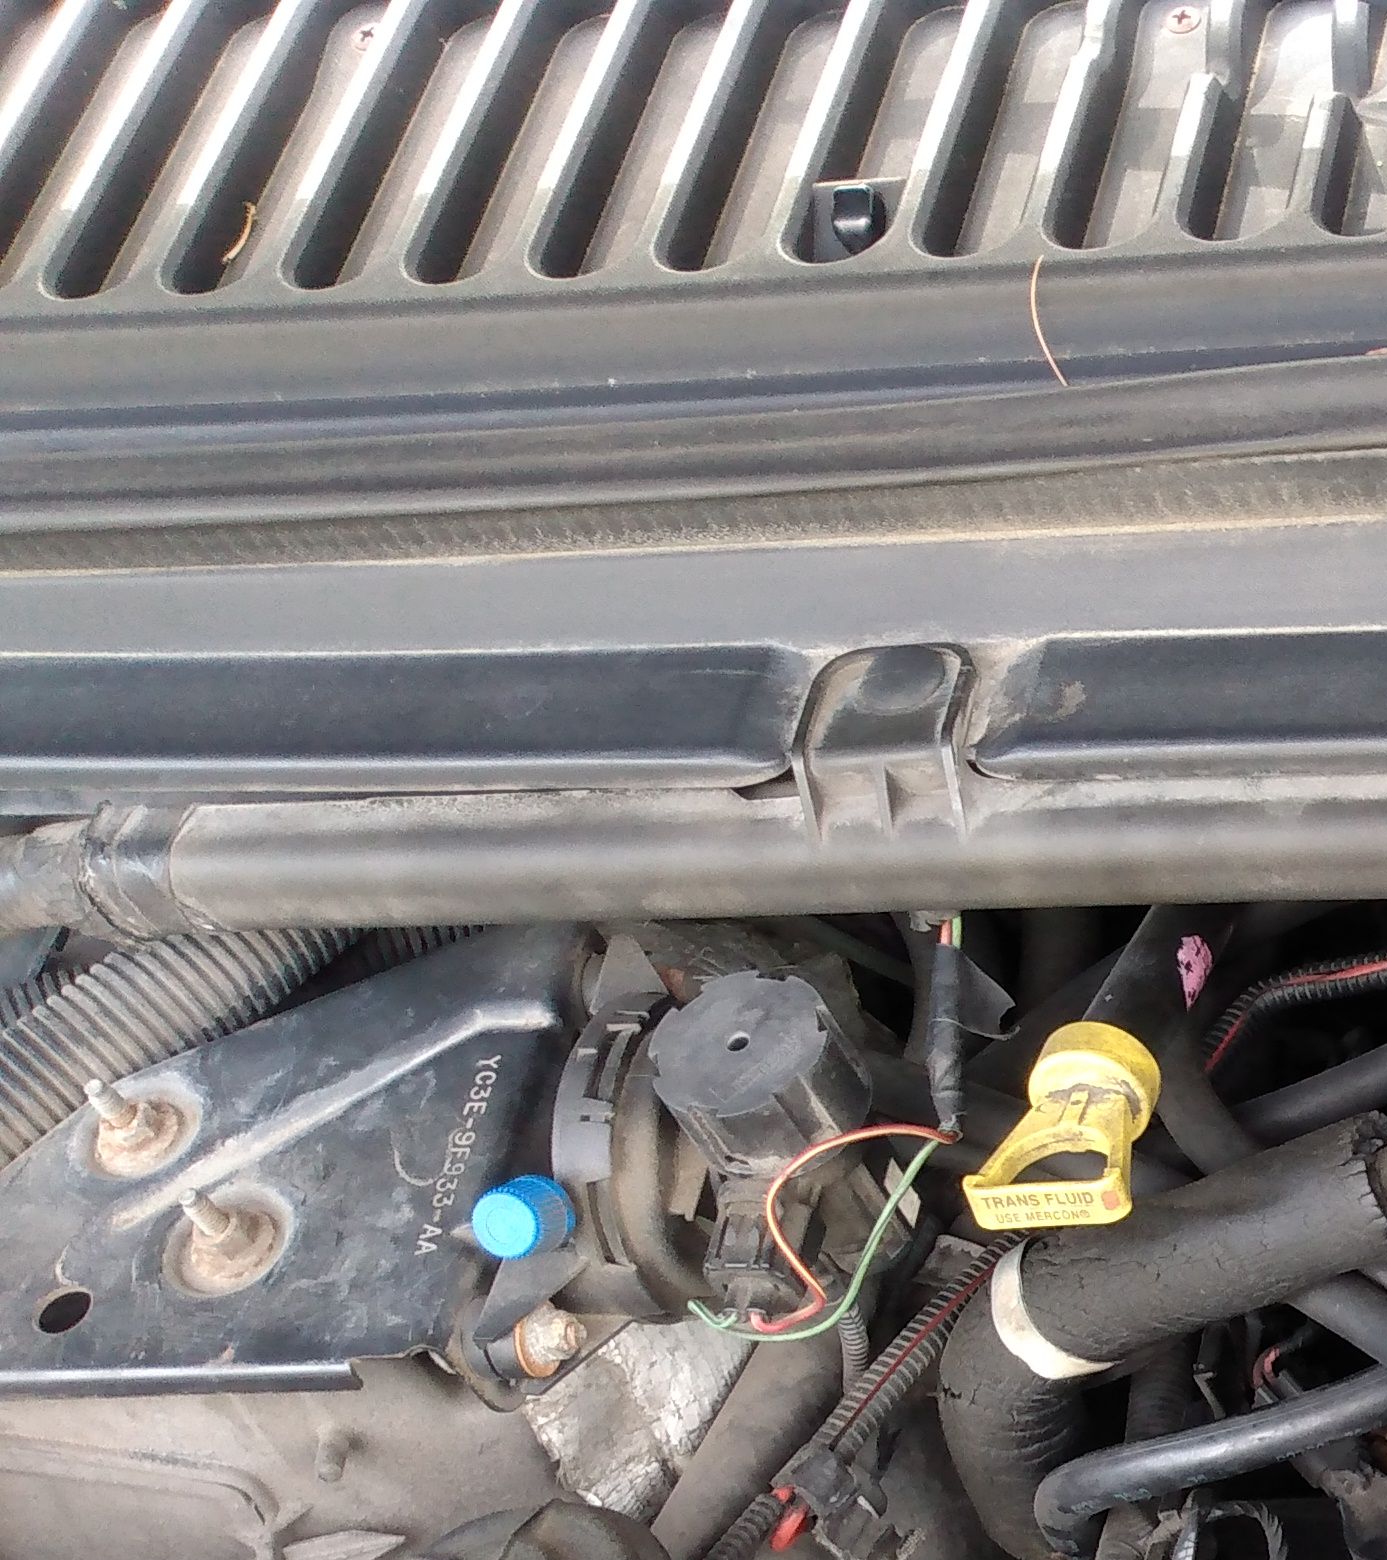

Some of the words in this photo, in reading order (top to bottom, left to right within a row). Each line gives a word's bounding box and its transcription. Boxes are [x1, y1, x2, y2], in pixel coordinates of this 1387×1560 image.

[414, 1055, 502, 1256] YC3E-9F933-AA
[981, 1193, 1041, 1210] TRANS
[1044, 1191, 1094, 1205] FLUID
[995, 1211, 1022, 1224] USE
